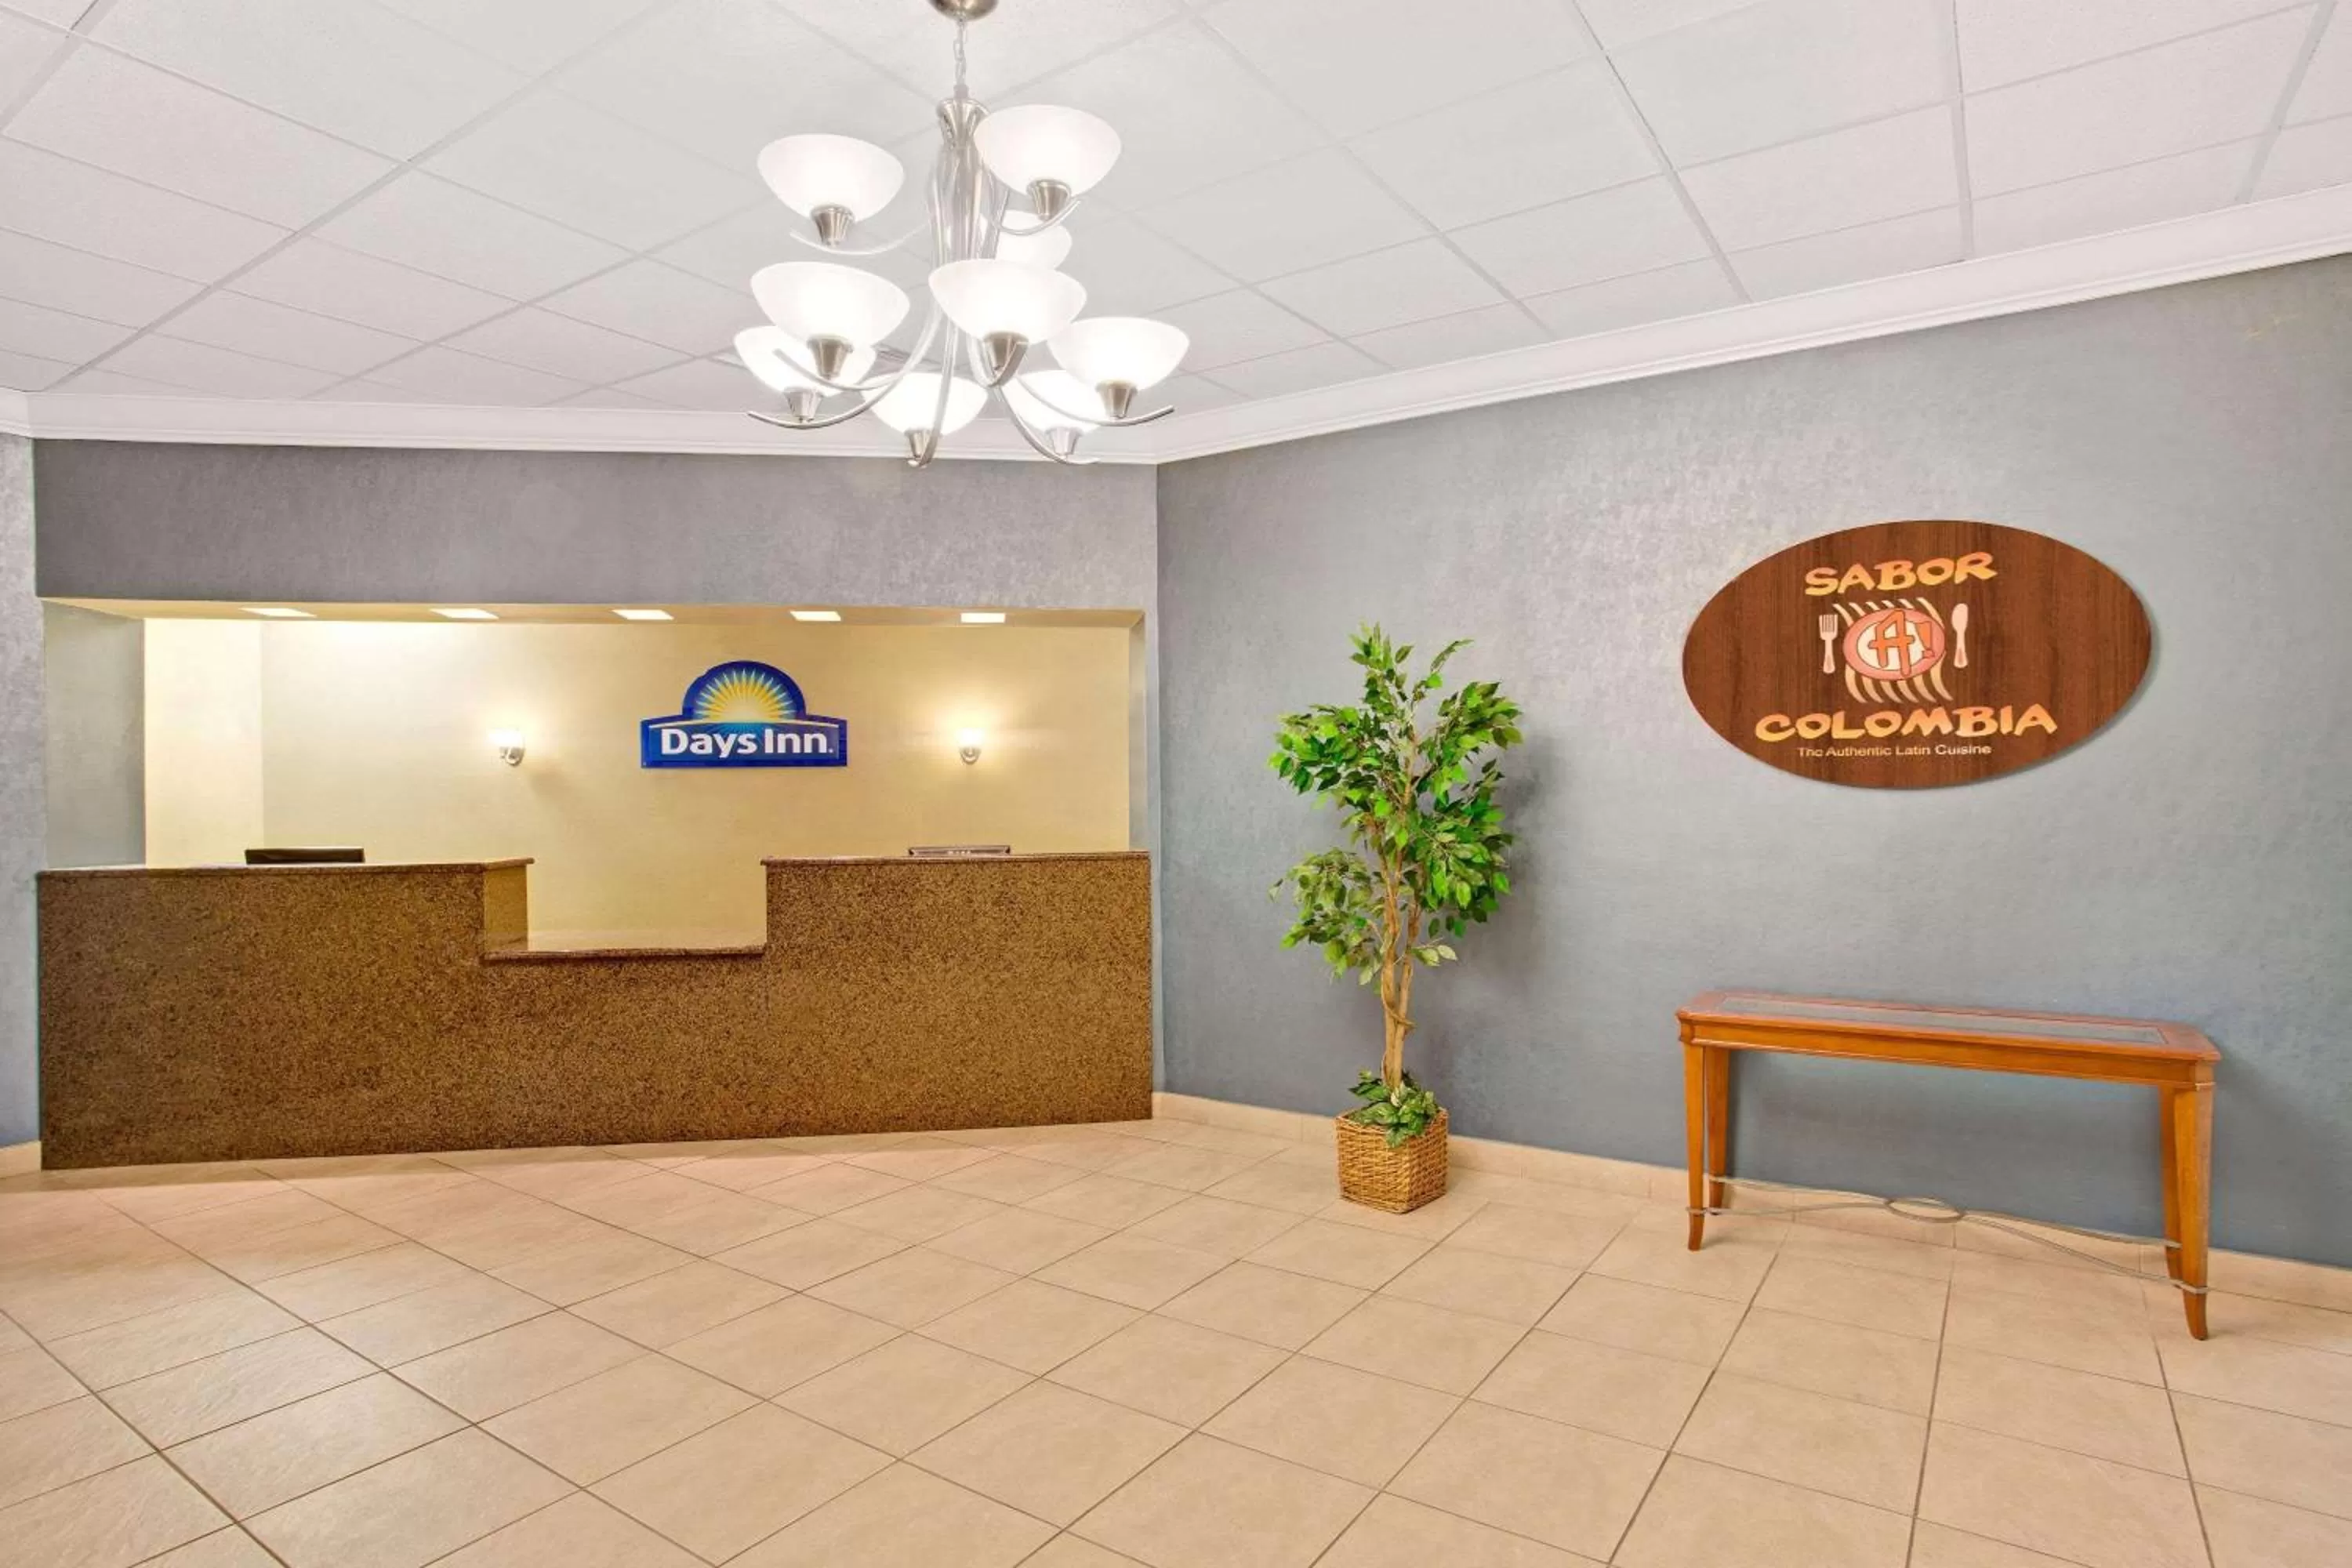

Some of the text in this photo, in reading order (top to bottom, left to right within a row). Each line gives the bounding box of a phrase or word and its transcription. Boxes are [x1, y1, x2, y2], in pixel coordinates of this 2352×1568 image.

[1805, 551, 1998, 597] SABOR
[1755, 703, 2058, 742] COLOMBIA
[661, 728, 757, 758] Days
[1825, 746, 1892, 757] Authentic
[1895, 744, 1931, 756] Latin
[1935, 743, 1992, 755] Cuisine
